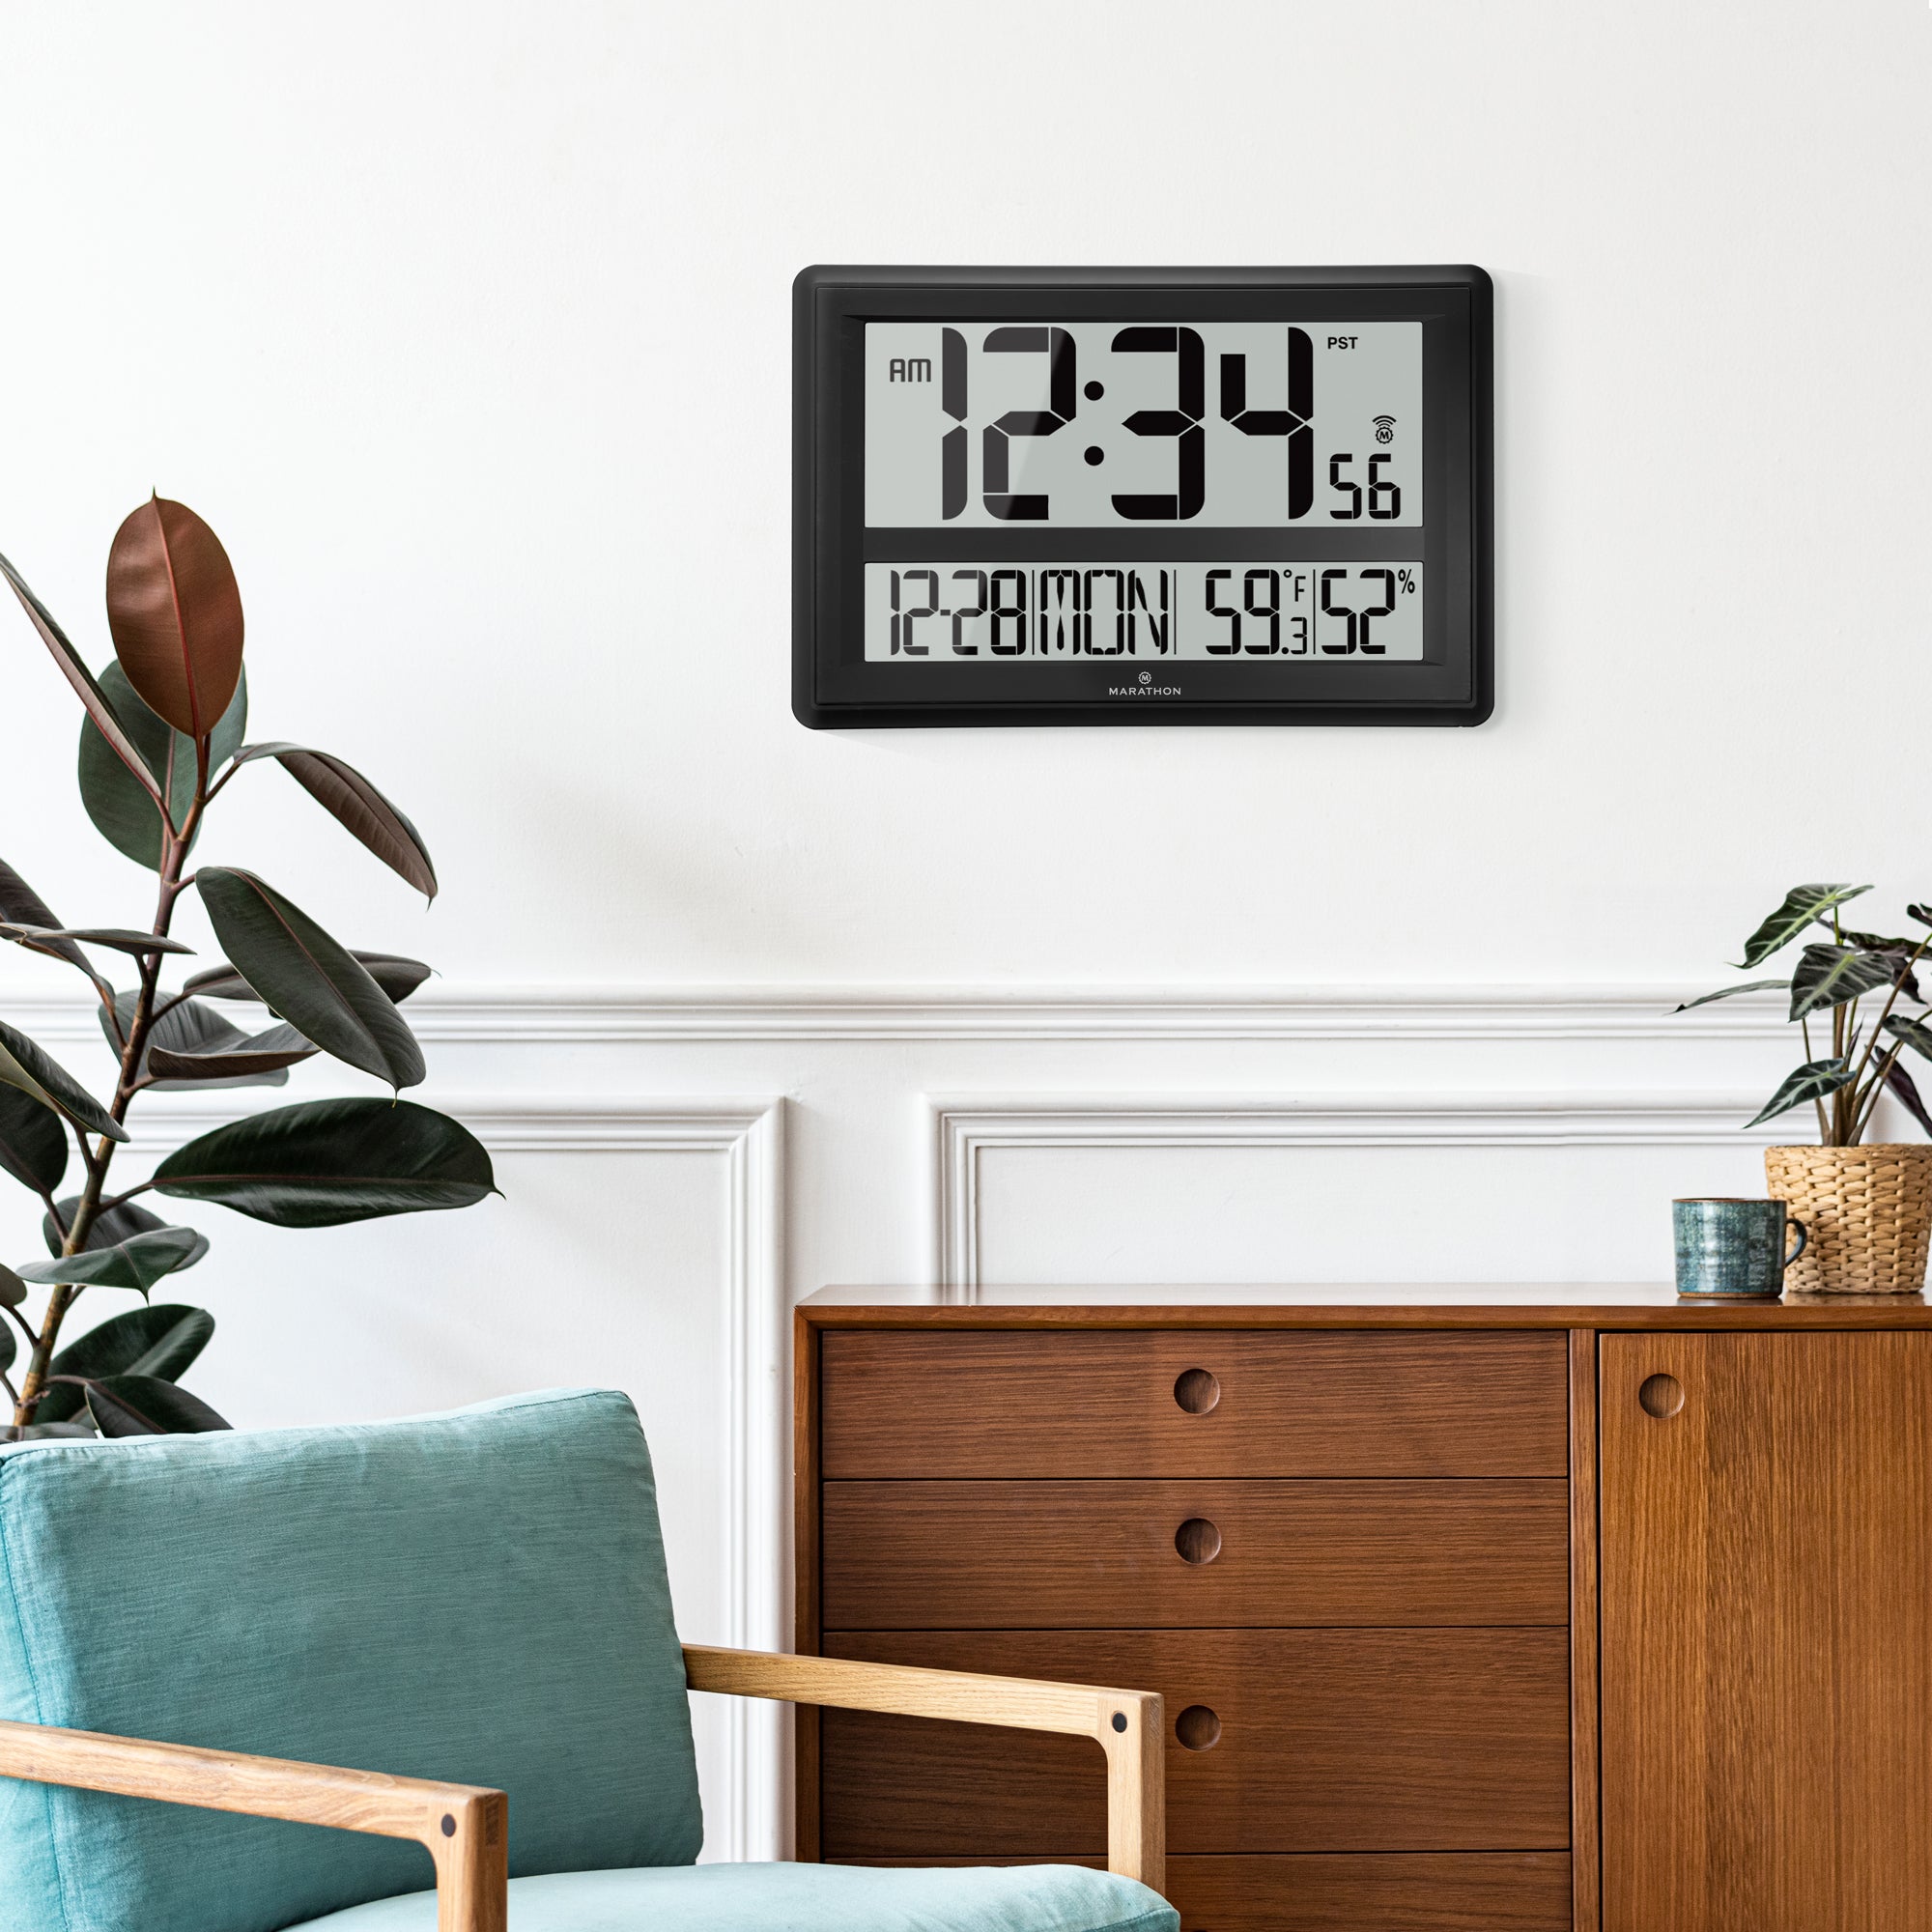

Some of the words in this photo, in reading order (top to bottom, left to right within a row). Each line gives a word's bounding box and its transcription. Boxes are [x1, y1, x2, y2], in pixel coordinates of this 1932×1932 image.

[1327, 336, 1358, 350] PST
[890, 358, 932, 383] AM
[942, 327, 1313, 520] 12:34
[1329, 453, 1401, 520] 56
[890, 569, 1027, 656] 12-28
[1039, 569, 1169, 656] MON
[1108, 687, 1181, 696] MARATHON
